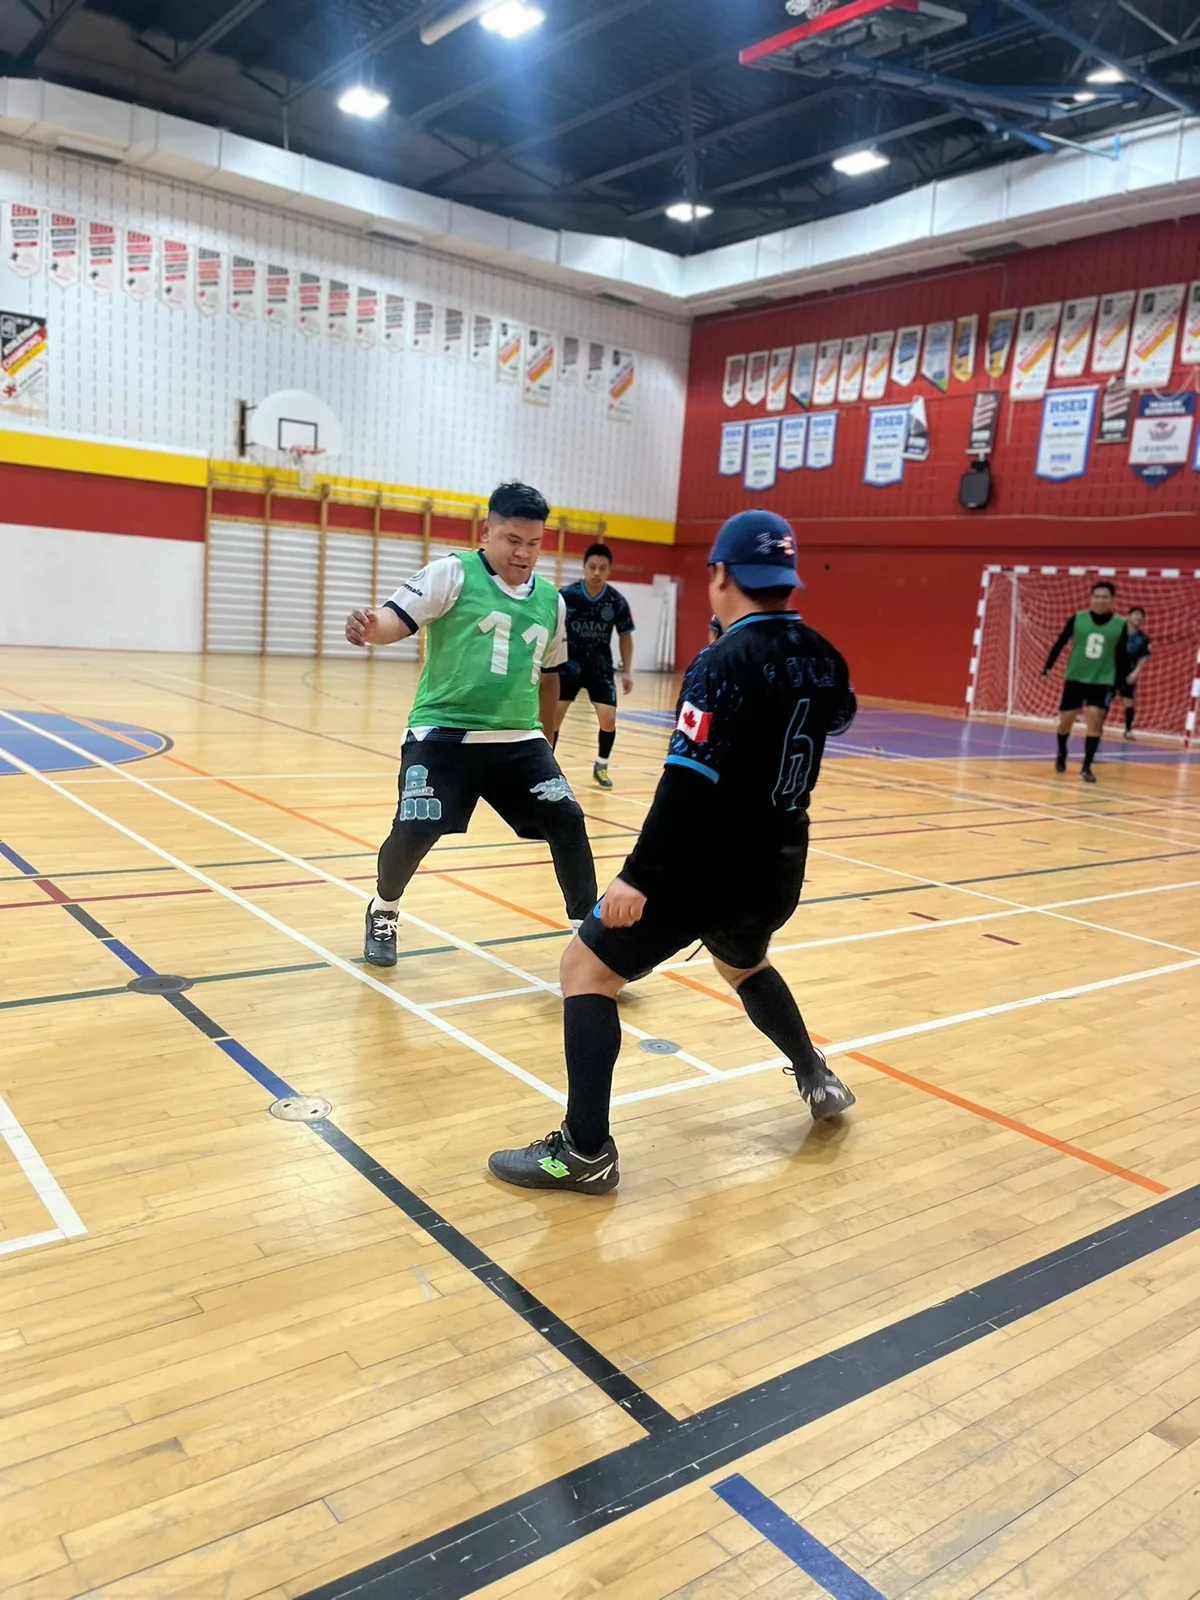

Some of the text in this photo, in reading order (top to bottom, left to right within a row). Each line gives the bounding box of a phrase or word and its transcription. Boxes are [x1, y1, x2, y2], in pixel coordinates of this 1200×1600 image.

[478, 610, 549, 685] 11
[1085, 632, 1105, 660] 6
[771, 698, 814, 811] 6
